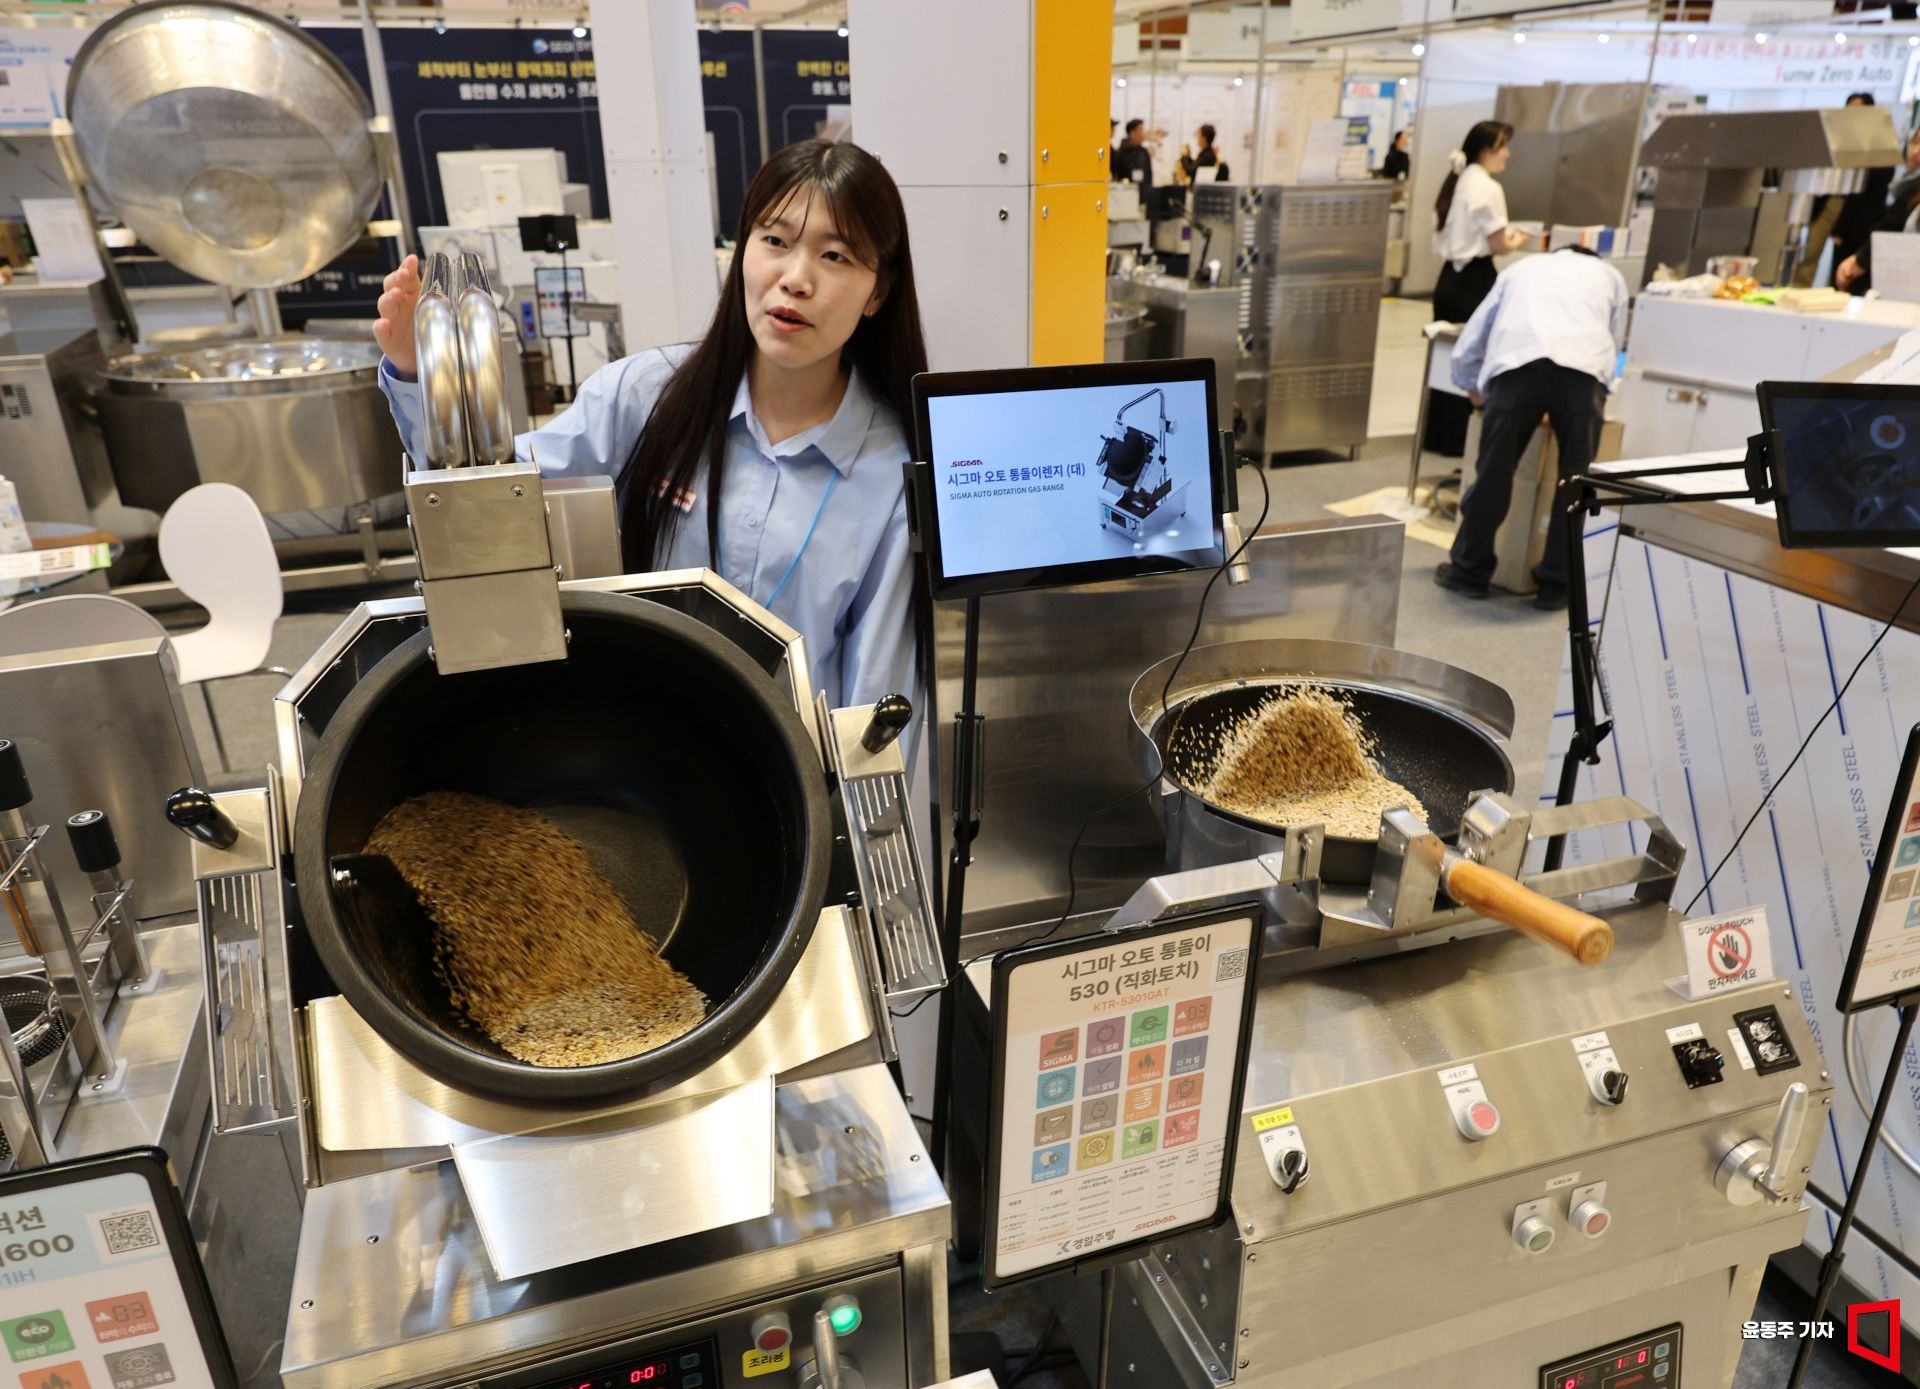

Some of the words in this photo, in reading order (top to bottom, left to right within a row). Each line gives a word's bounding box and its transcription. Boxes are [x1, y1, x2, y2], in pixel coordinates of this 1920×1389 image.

[1776, 66, 1815, 82] Fume
[1820, 66, 1853, 82] Zero
[1859, 66, 1893, 82] Auto
[948, 470, 981, 486] 시그마
[984, 469, 1006, 484] 오토
[1009, 464, 1063, 482] 통돌이렌지
[1066, 462, 1086, 478] (대)
[950, 459, 983, 468] SIGMA
[949, 491, 972, 501] SIGMA
[973, 489, 992, 499] AUTO
[993, 486, 1027, 497] ROTATION
[1028, 484, 1042, 494] GAS
[1042, 483, 1065, 493] RANGE
[1665, 666, 1679, 700] STEEL
[1747, 698, 1762, 737] STEEL
[1671, 704, 1691, 766] STAINLESS
[1843, 740, 1860, 781] STEEL
[1850, 787, 1875, 858] STAINLESS
[1726, 916, 1754, 928] TOUCH
[1061, 958, 1116, 981] 시그마
[1119, 948, 1155, 969] 오토
[1160, 934, 1212, 960] 통돌이
[1069, 981, 1110, 1002] 530
[1115, 960, 1200, 996] (직화토치)
[1093, 988, 1170, 1012] KTR-5301GAT
[1800, 974, 1816, 1014] STEEL
[1043, 1054, 1074, 1068] SIGMA
[1132, 1215, 1177, 1232] SIGMA
[1073, 1229, 1116, 1250] 경일주방
[20, 1323, 49, 1338] eco
